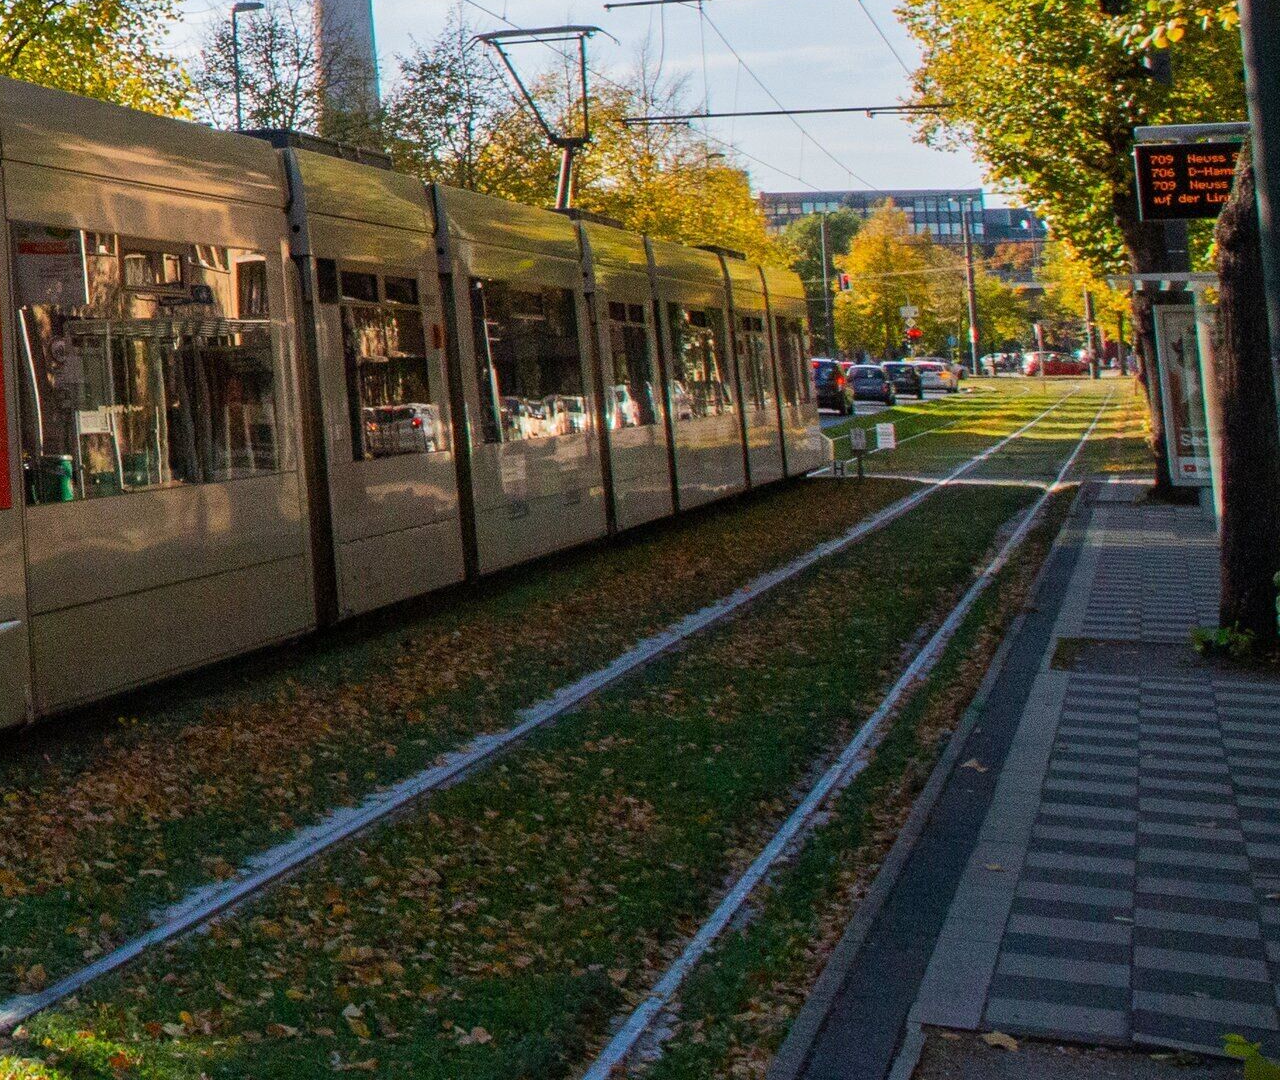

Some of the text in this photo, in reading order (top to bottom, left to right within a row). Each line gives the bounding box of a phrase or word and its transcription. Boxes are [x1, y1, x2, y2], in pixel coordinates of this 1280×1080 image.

[1150, 155, 1174, 165] 709
[1187, 153, 1226, 164] Neuss
[1152, 168, 1175, 178] 706
[1153, 180, 1229, 190] 709 Neuss
[1178, 193, 1200, 204] der
